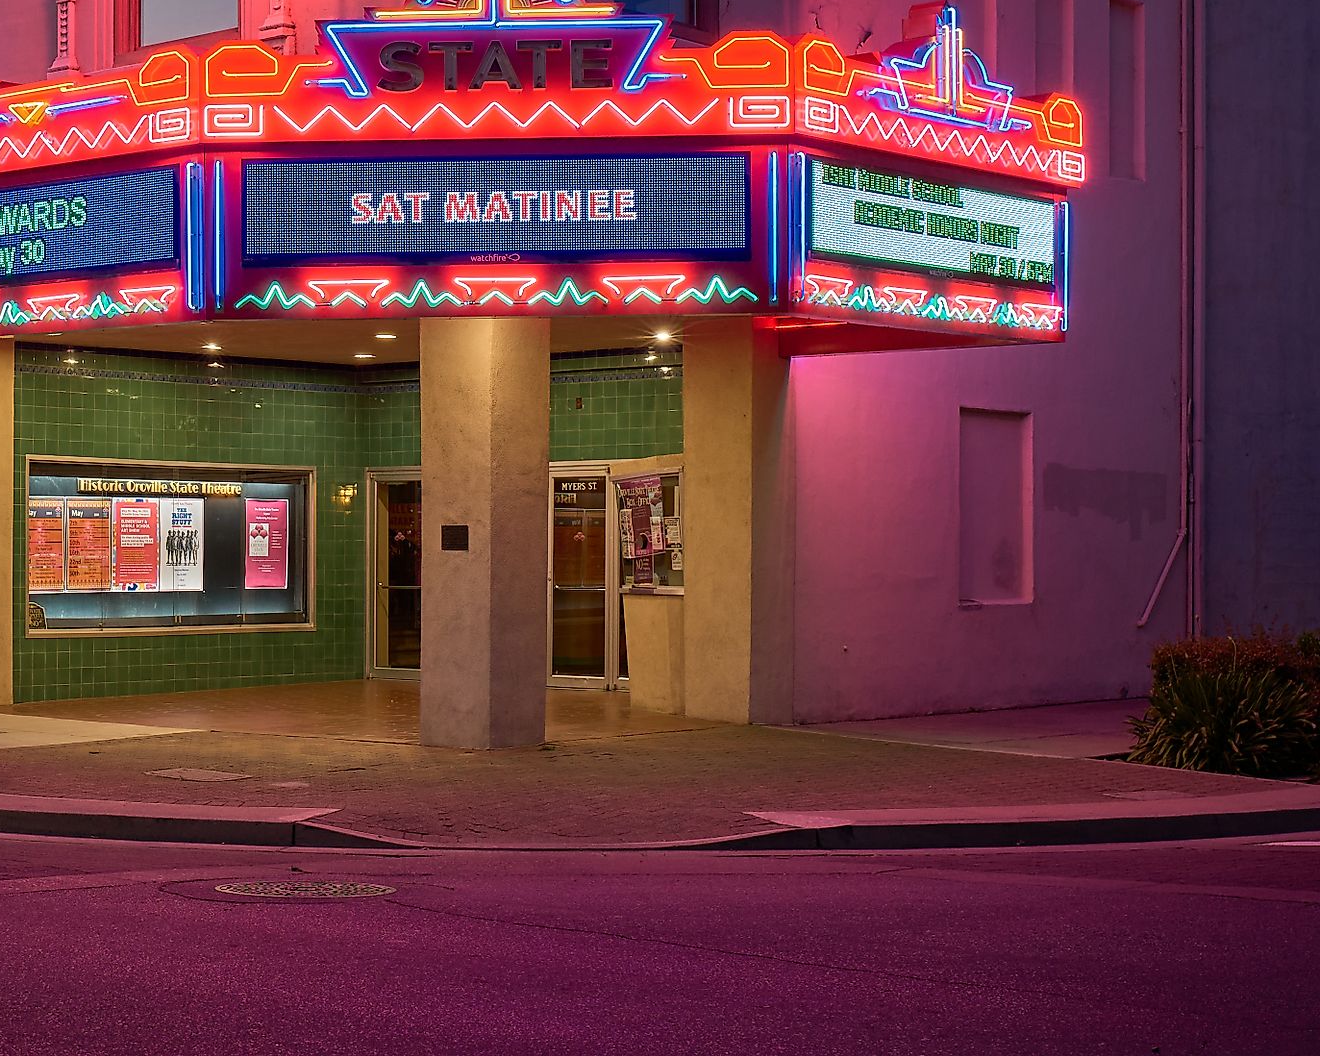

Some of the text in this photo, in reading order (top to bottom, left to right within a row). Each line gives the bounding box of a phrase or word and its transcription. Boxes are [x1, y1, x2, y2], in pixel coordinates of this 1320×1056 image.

[374, 38, 616, 94] STATE
[822, 164, 963, 208] ISHI MIDDLE SCHOOL
[350, 188, 638, 225] SAT MATINEE
[854, 200, 1020, 249] ACADEMIC HONORS NIGHT
[20, 237, 46, 265] 30
[470, 252, 508, 264] watchfire
[78, 479, 242, 496] Historic Oroville State Theatre
[561, 482, 587, 491] MYERS
[71, 509, 84, 518] May
